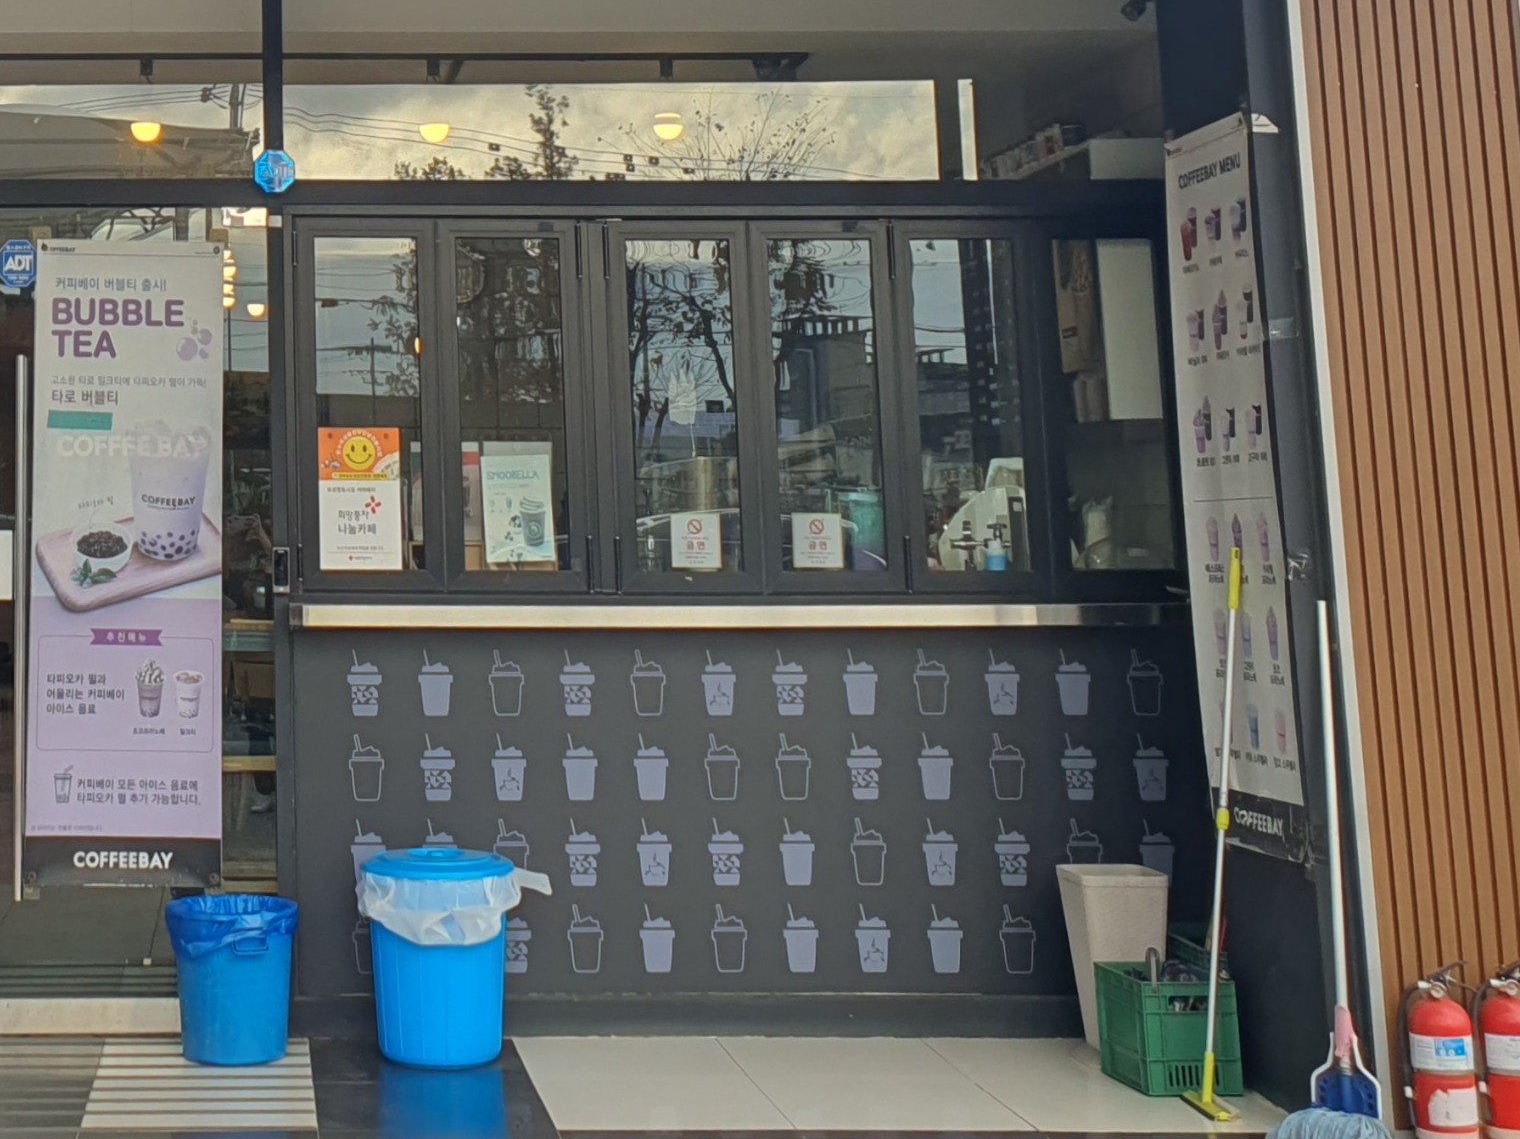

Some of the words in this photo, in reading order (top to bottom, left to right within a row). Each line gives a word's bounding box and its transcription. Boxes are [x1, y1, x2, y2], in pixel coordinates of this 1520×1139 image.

[4, 255, 33, 271] ADT
[55, 277, 99, 291] 커피베이
[104, 278, 136, 292] 버블티
[141, 278, 167, 292] 출시!
[51, 297, 185, 327] BUBBLE
[51, 329, 117, 358] TEA
[51, 389, 77, 404] 타로
[81, 390, 119, 406] 버블티
[141, 493, 196, 508] COFFEEBAY
[46, 673, 84, 685] 타피오카
[46, 688, 84, 700] 어울리는
[88, 689, 125, 701] 커피베이
[46, 703, 75, 714] 아이스
[77, 703, 97, 715] 음료
[77, 778, 115, 790] 커피베이
[117, 779, 136, 791] 모든
[139, 779, 167, 791] 아이스
[170, 779, 199, 792] 음료에
[77, 792, 114, 804] 타피오카
[129, 793, 149, 805] 추가
[151, 793, 202, 806] 가능합니다.
[73, 850, 174, 870] COFFEEBAY
